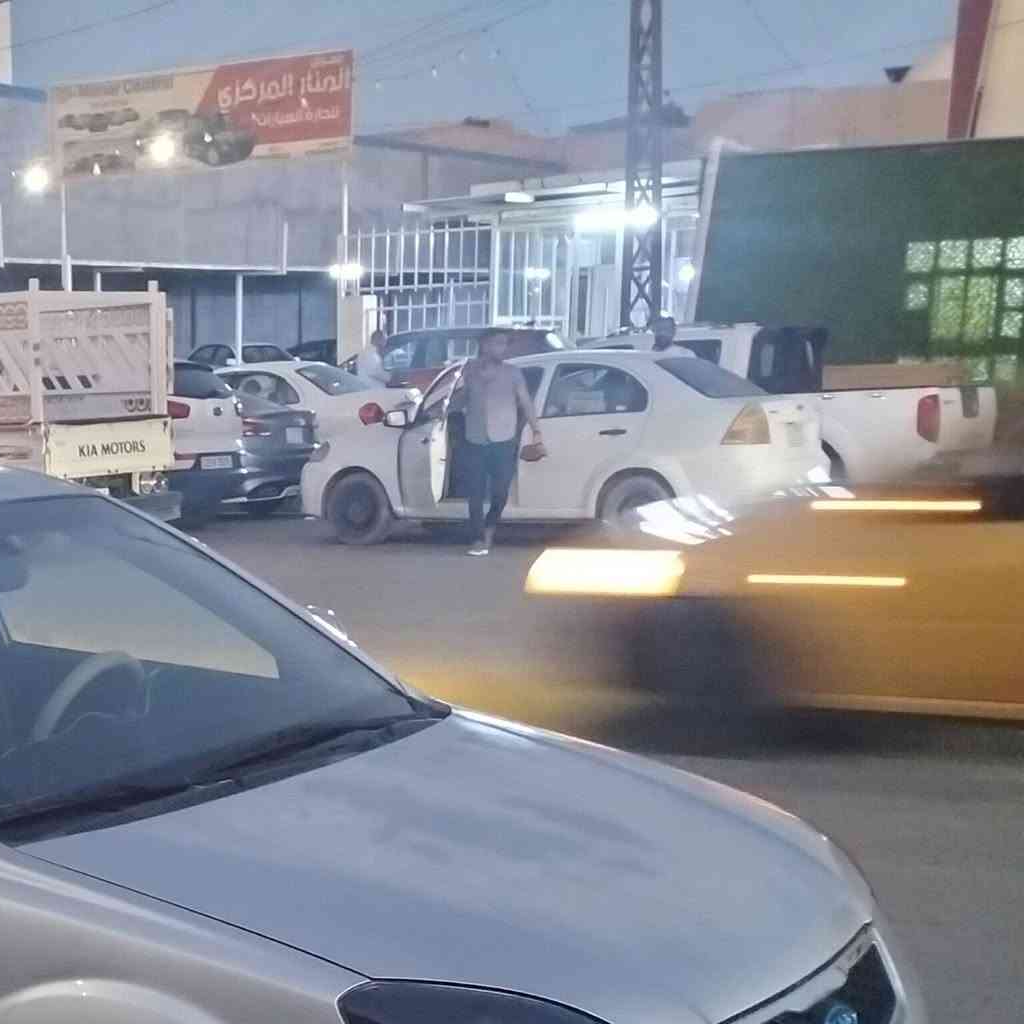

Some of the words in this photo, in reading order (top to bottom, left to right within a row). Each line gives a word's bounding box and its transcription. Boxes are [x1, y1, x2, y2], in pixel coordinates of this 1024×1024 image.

[299, 64, 350, 98] المنار
[78, 444, 98, 458] KIA
[101, 440, 146, 456] MOTORS
